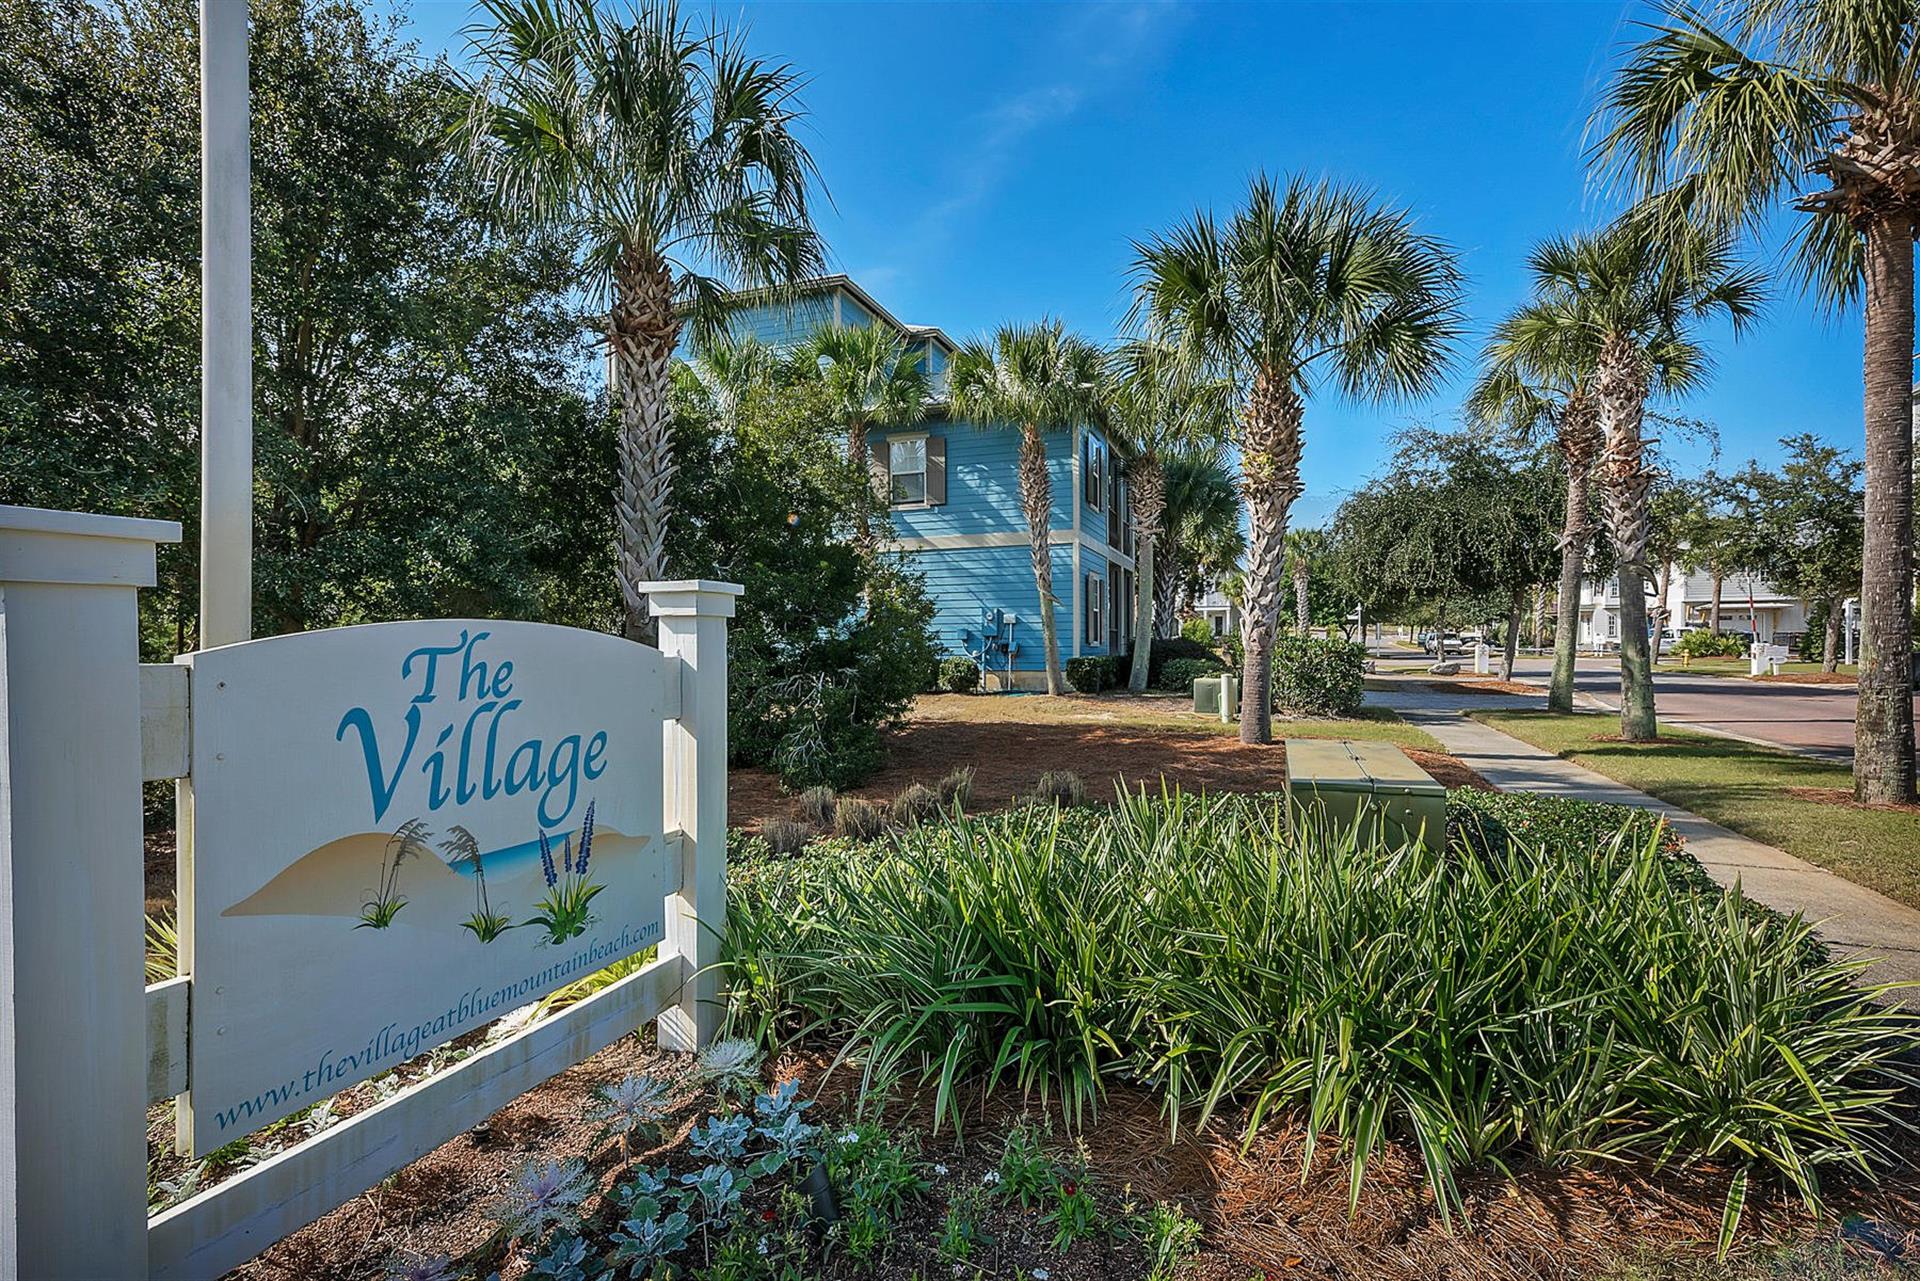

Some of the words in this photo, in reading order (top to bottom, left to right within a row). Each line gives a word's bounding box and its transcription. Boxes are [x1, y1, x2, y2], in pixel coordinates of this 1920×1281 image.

[402, 629, 514, 703] The
[336, 699, 608, 829] Village
[214, 921, 660, 1131] www.thevillageatbluemountainbeach.com
